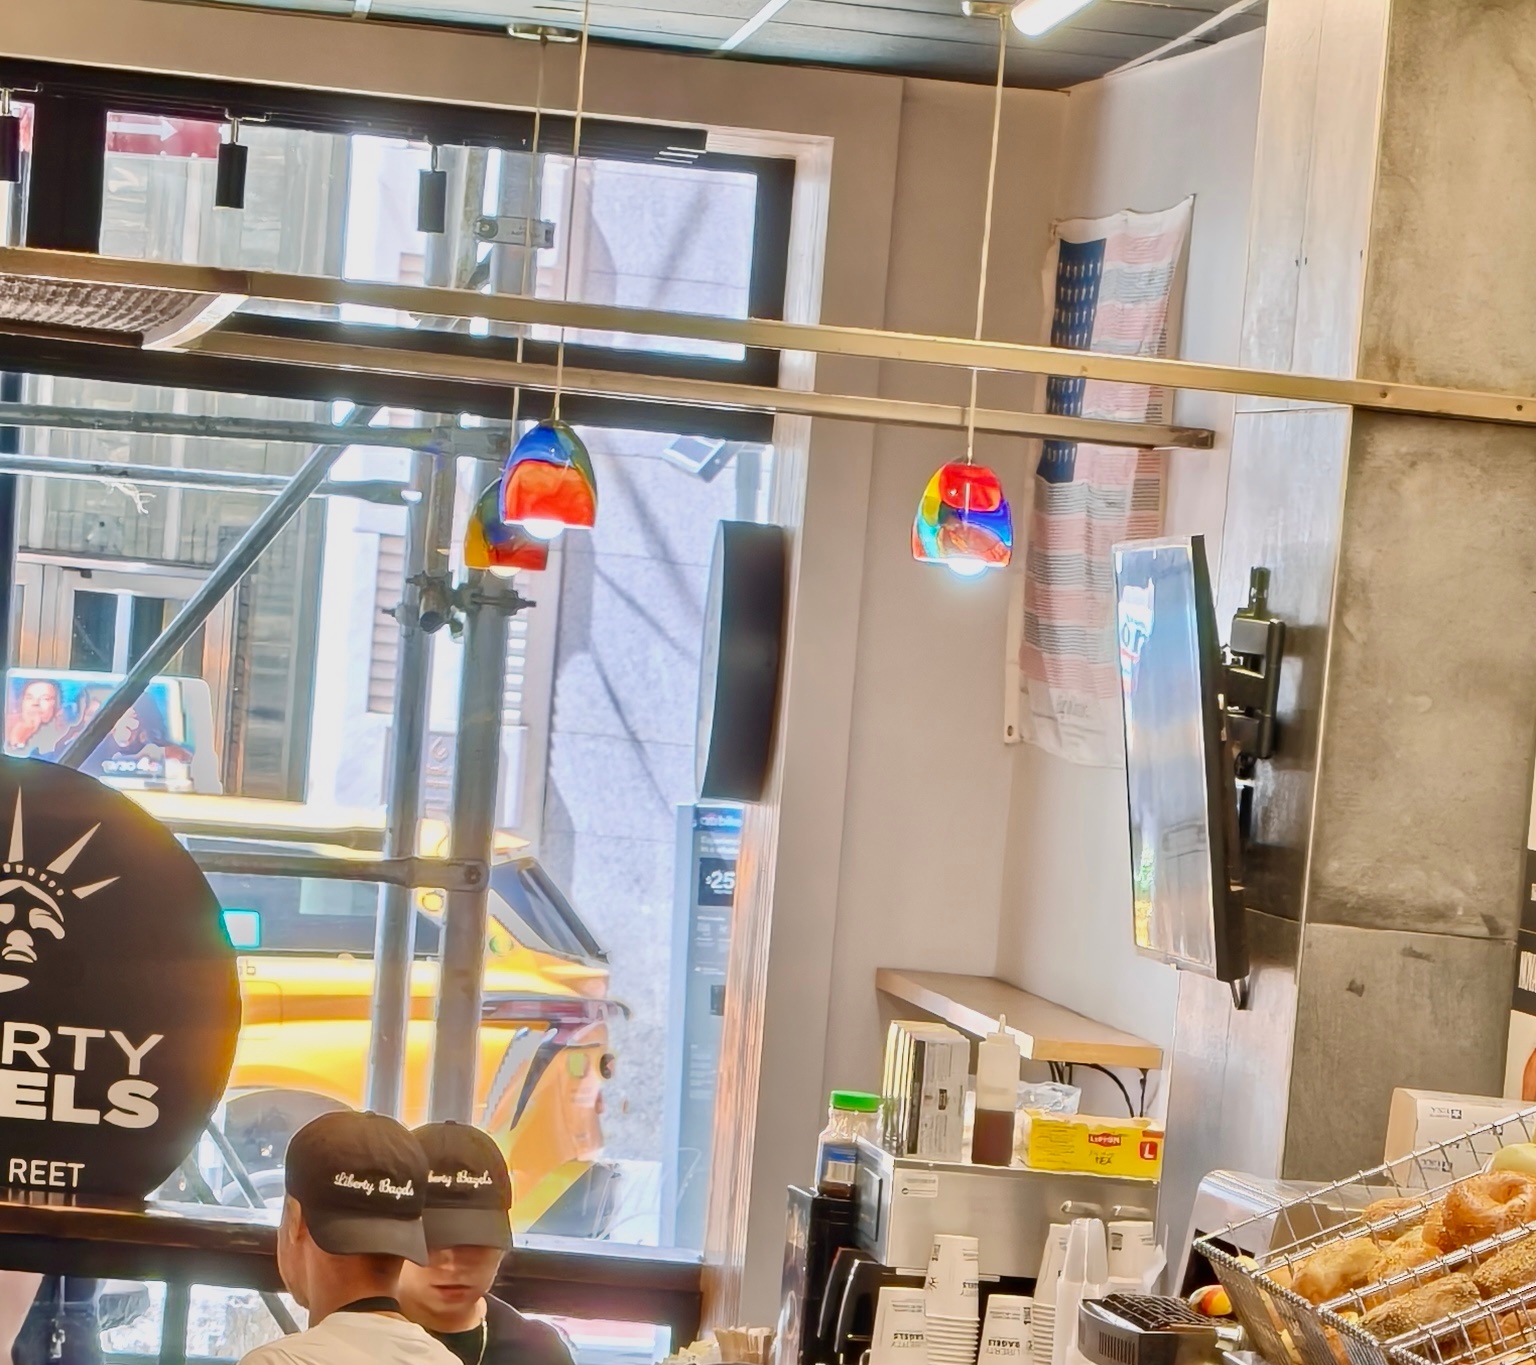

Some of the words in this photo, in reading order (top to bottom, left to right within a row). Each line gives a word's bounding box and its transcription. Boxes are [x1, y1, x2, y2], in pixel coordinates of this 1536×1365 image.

[2, 1021, 164, 1076] RTY
[8, 1158, 86, 1188] REET
[334, 1172, 375, 1196] Liberty
[428, 1170, 453, 1187] berty
